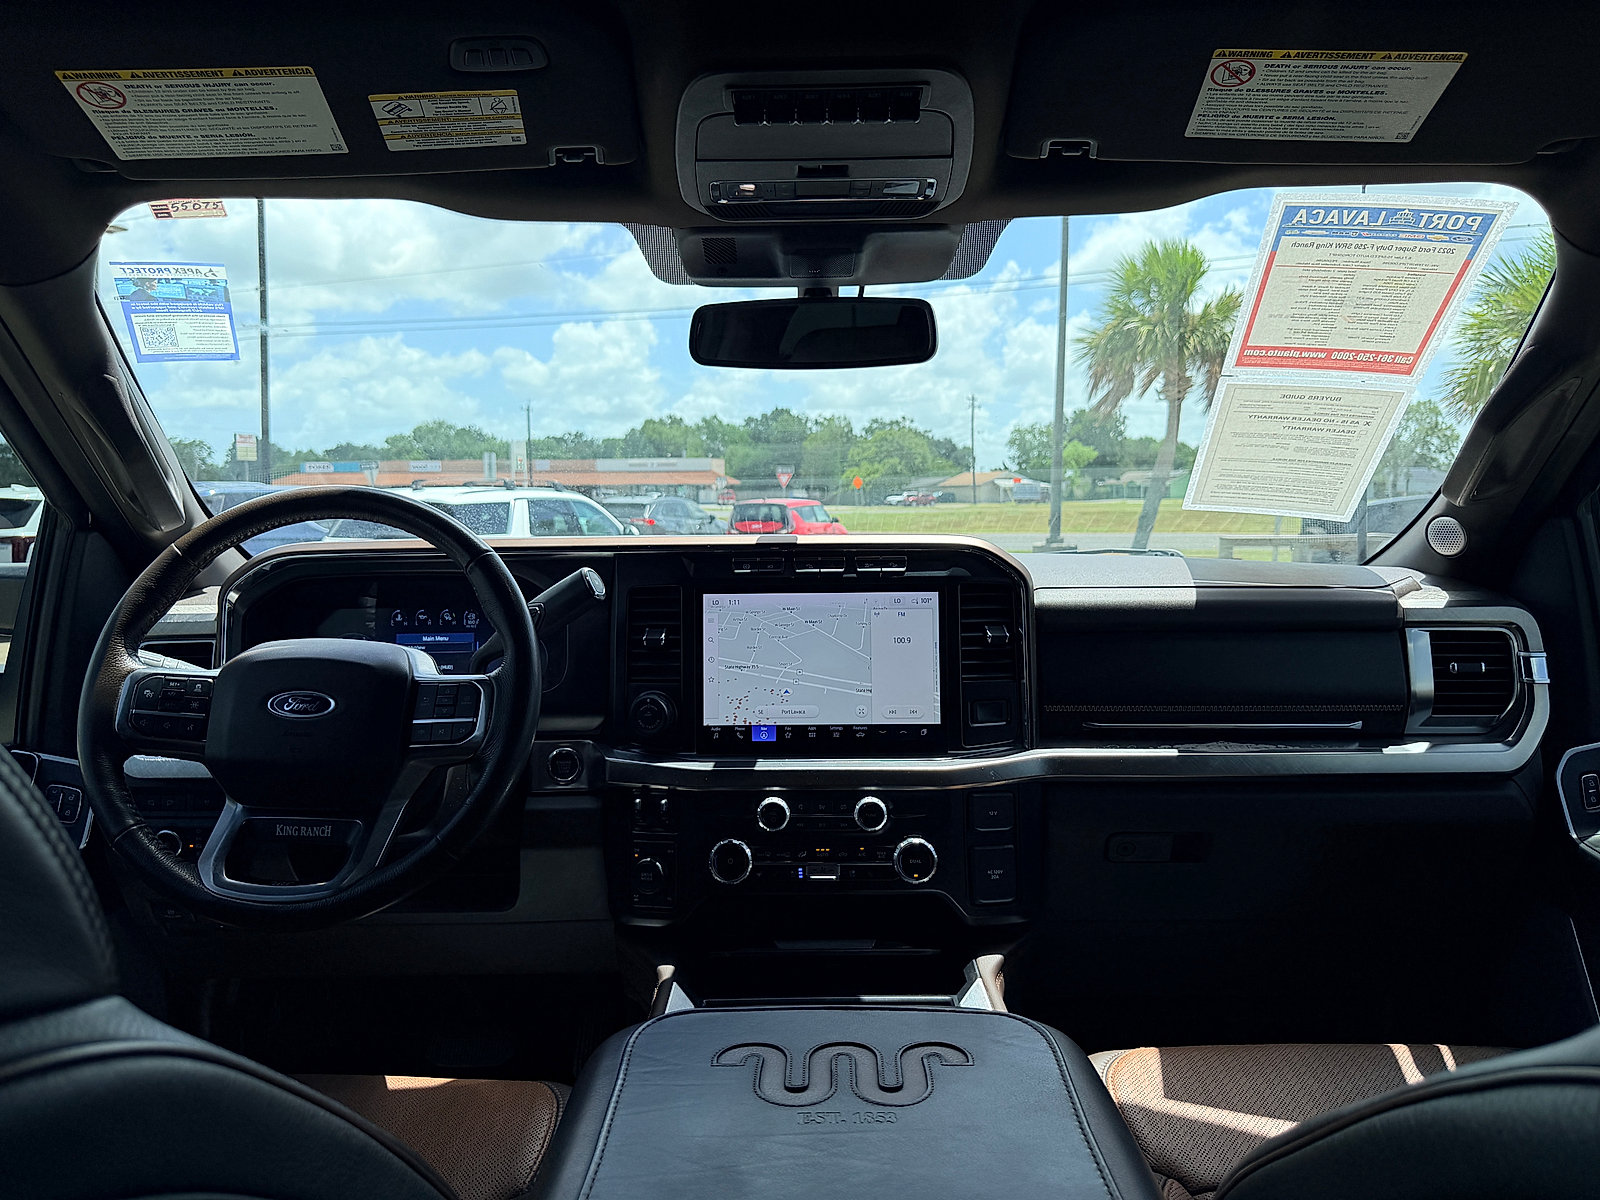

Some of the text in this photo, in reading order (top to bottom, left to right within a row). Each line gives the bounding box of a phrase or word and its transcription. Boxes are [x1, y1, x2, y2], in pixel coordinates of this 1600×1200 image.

[1226, 50, 1274, 58] WARNING
[1292, 51, 1376, 59] AVERTISSEMENT
[1392, 52, 1465, 61] ADVERTENCIA
[69, 71, 122, 79] WARNING
[139, 70, 226, 78] AVERTISSEMENT
[242, 68, 313, 76] ADVERTENCIA
[276, 824, 332, 838] KING RANCH
[797, 1111, 898, 1125] EST. 1853
